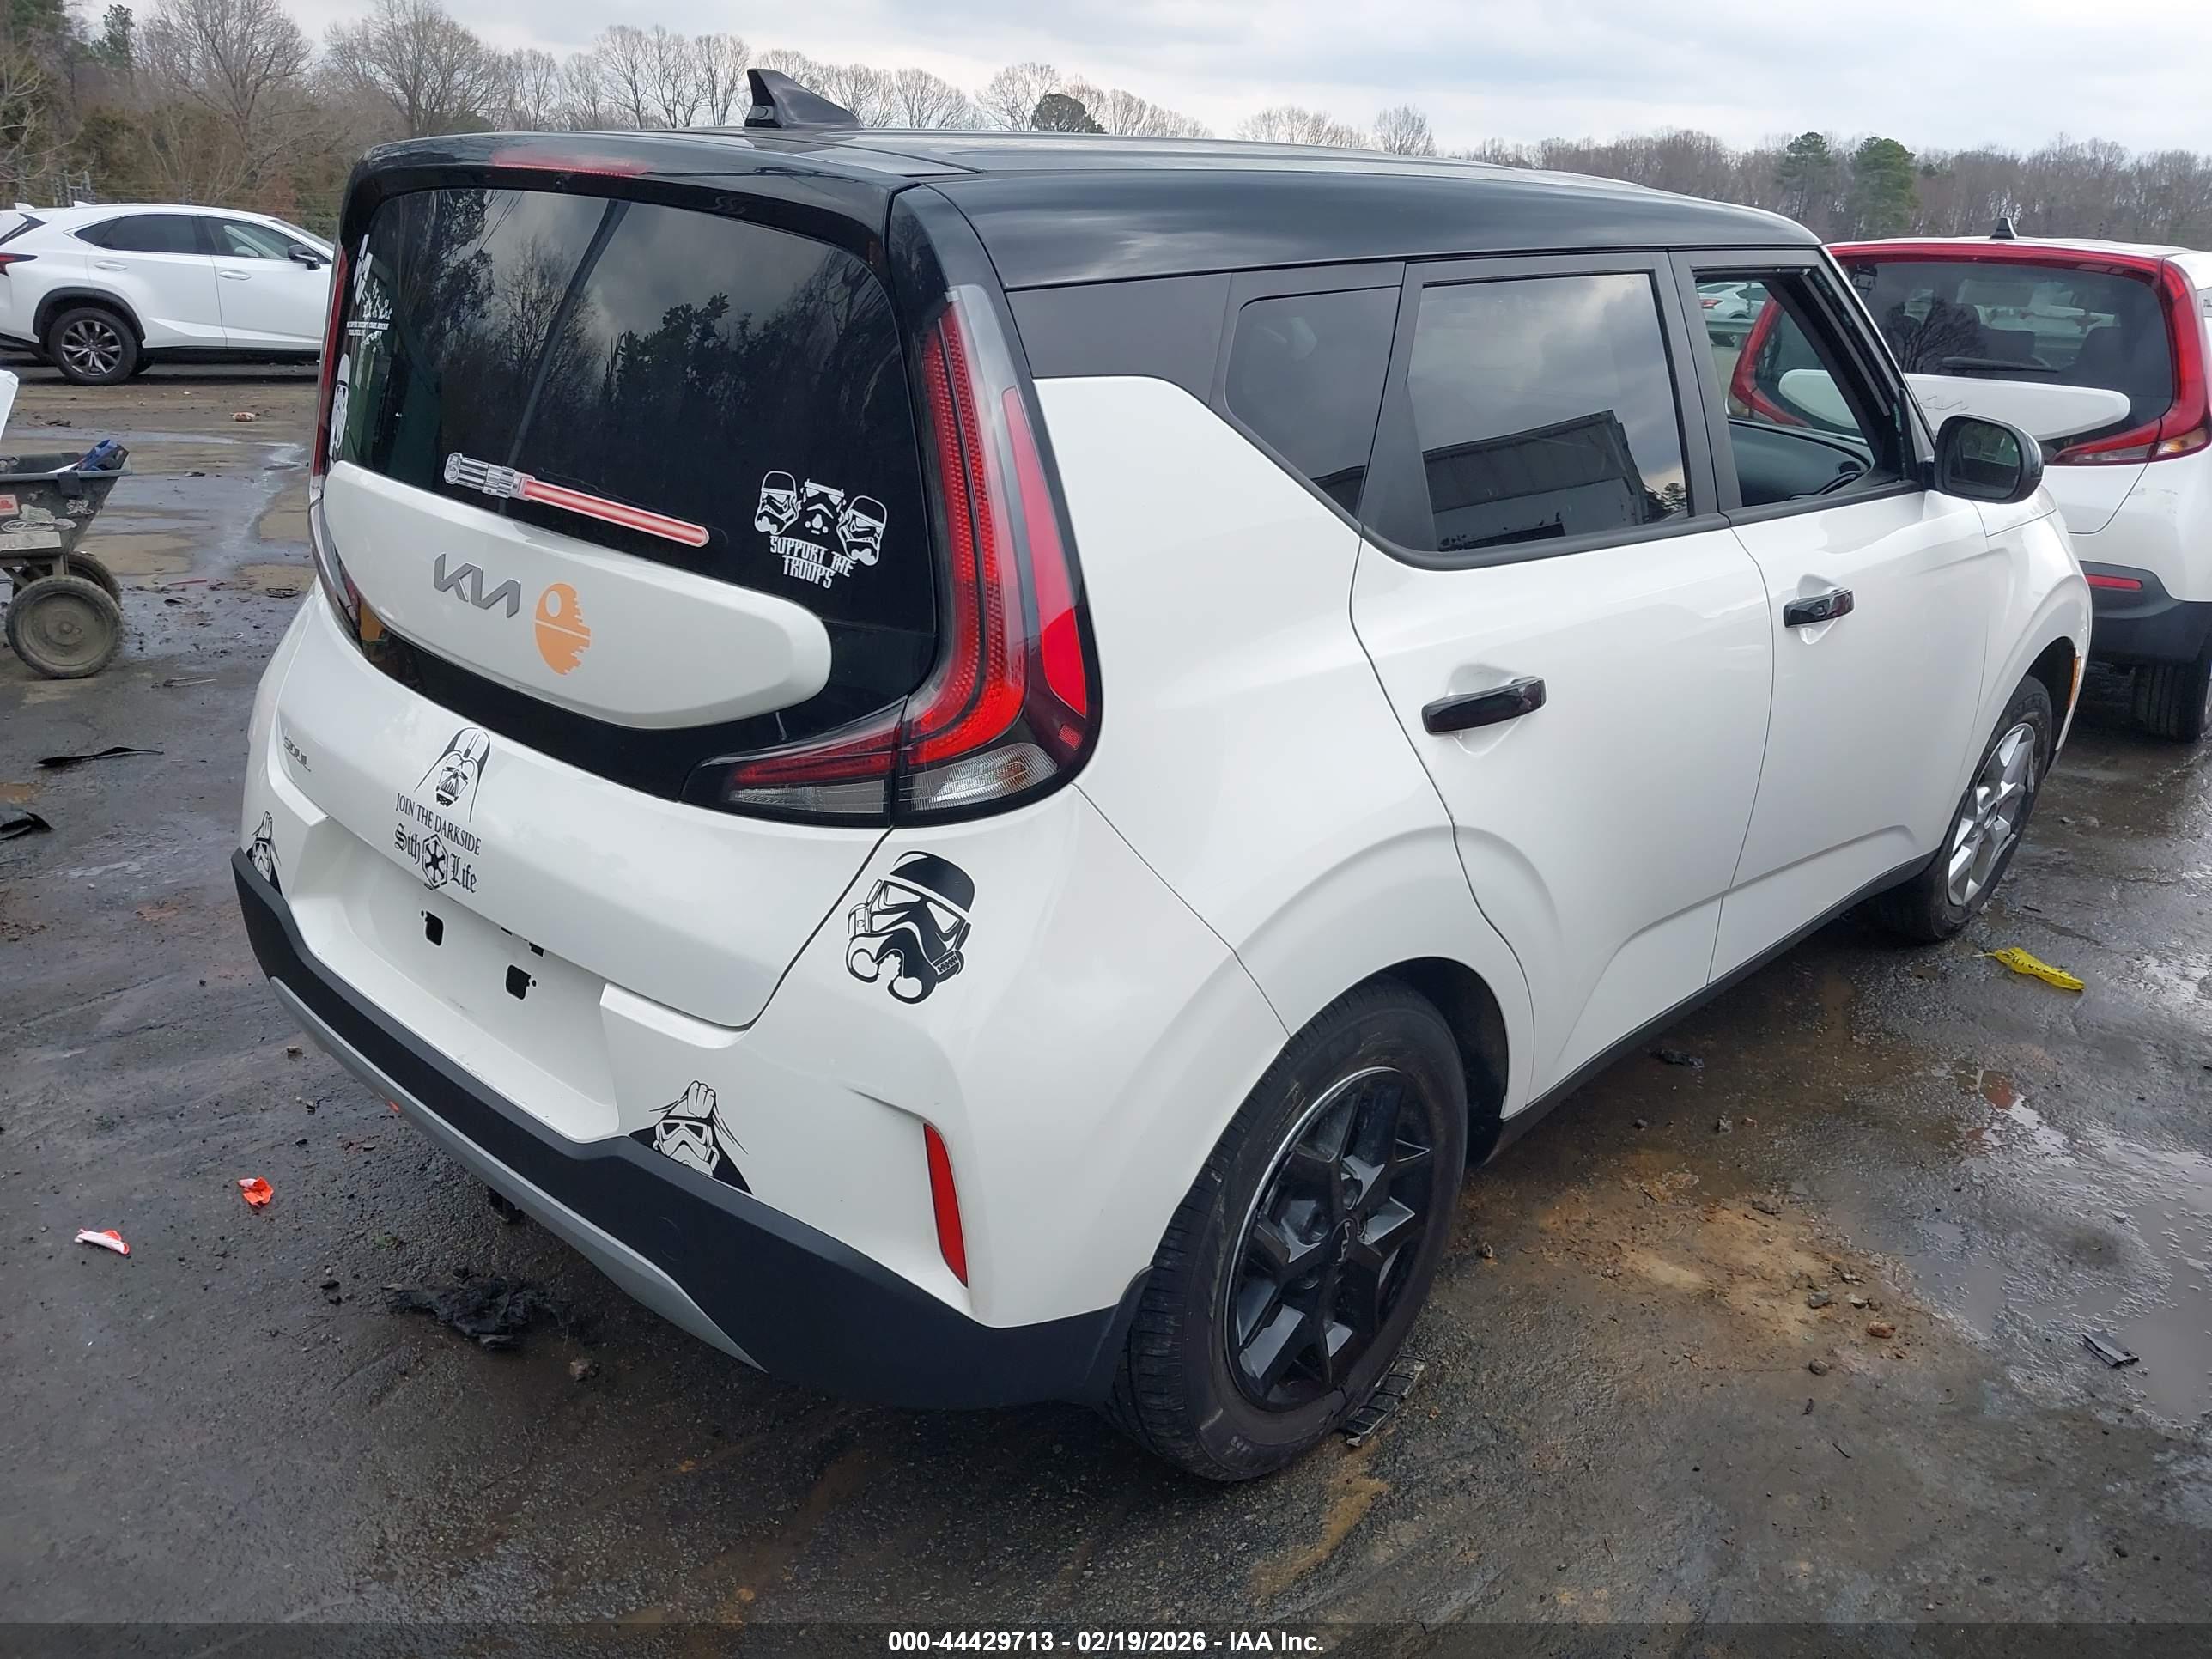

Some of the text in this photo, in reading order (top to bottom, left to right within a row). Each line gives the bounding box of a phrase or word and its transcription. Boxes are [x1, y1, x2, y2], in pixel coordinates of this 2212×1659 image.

[433, 551, 522, 619] KIA
[769, 535, 858, 578] SUPPORT THE
[781, 555, 836, 589] TROOPS
[395, 792, 482, 856] JOIN THE DARKSIDE
[393, 822, 477, 894] Sith Life
